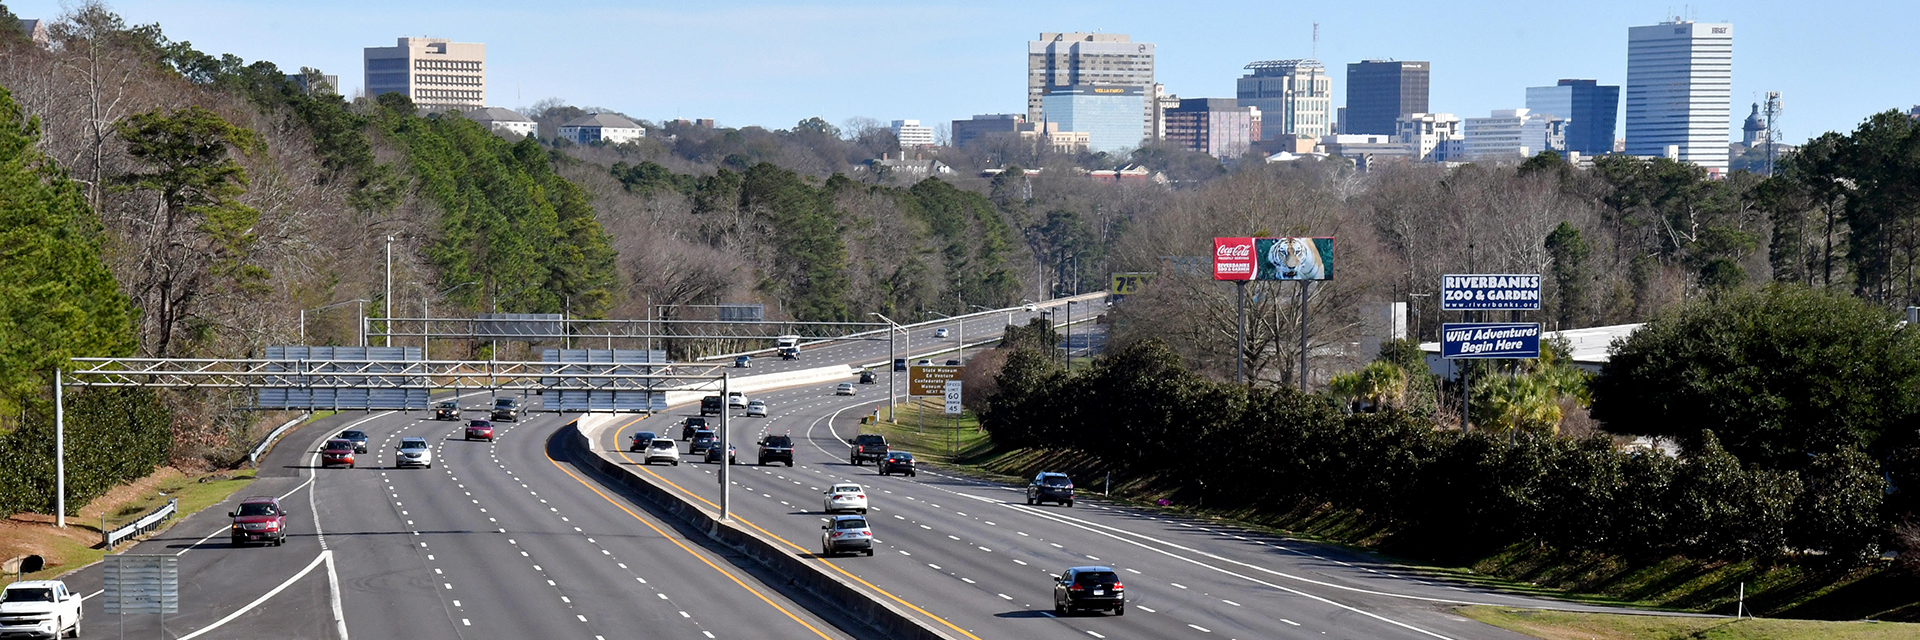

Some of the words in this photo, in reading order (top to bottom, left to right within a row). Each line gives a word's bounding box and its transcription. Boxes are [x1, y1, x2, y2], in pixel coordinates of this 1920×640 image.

[1216, 244, 1251, 256] Coca-Cola
[1445, 276, 1538, 288] RIVERBANKS
[1445, 290, 1473, 300] ZOO
[1475, 290, 1485, 300] &
[1487, 290, 1538, 300] GARDEN
[1446, 330, 1472, 342] Wild
[1473, 328, 1537, 340] Adventures
[1461, 341, 1493, 353] Begin
[1495, 340, 1523, 350] Here
